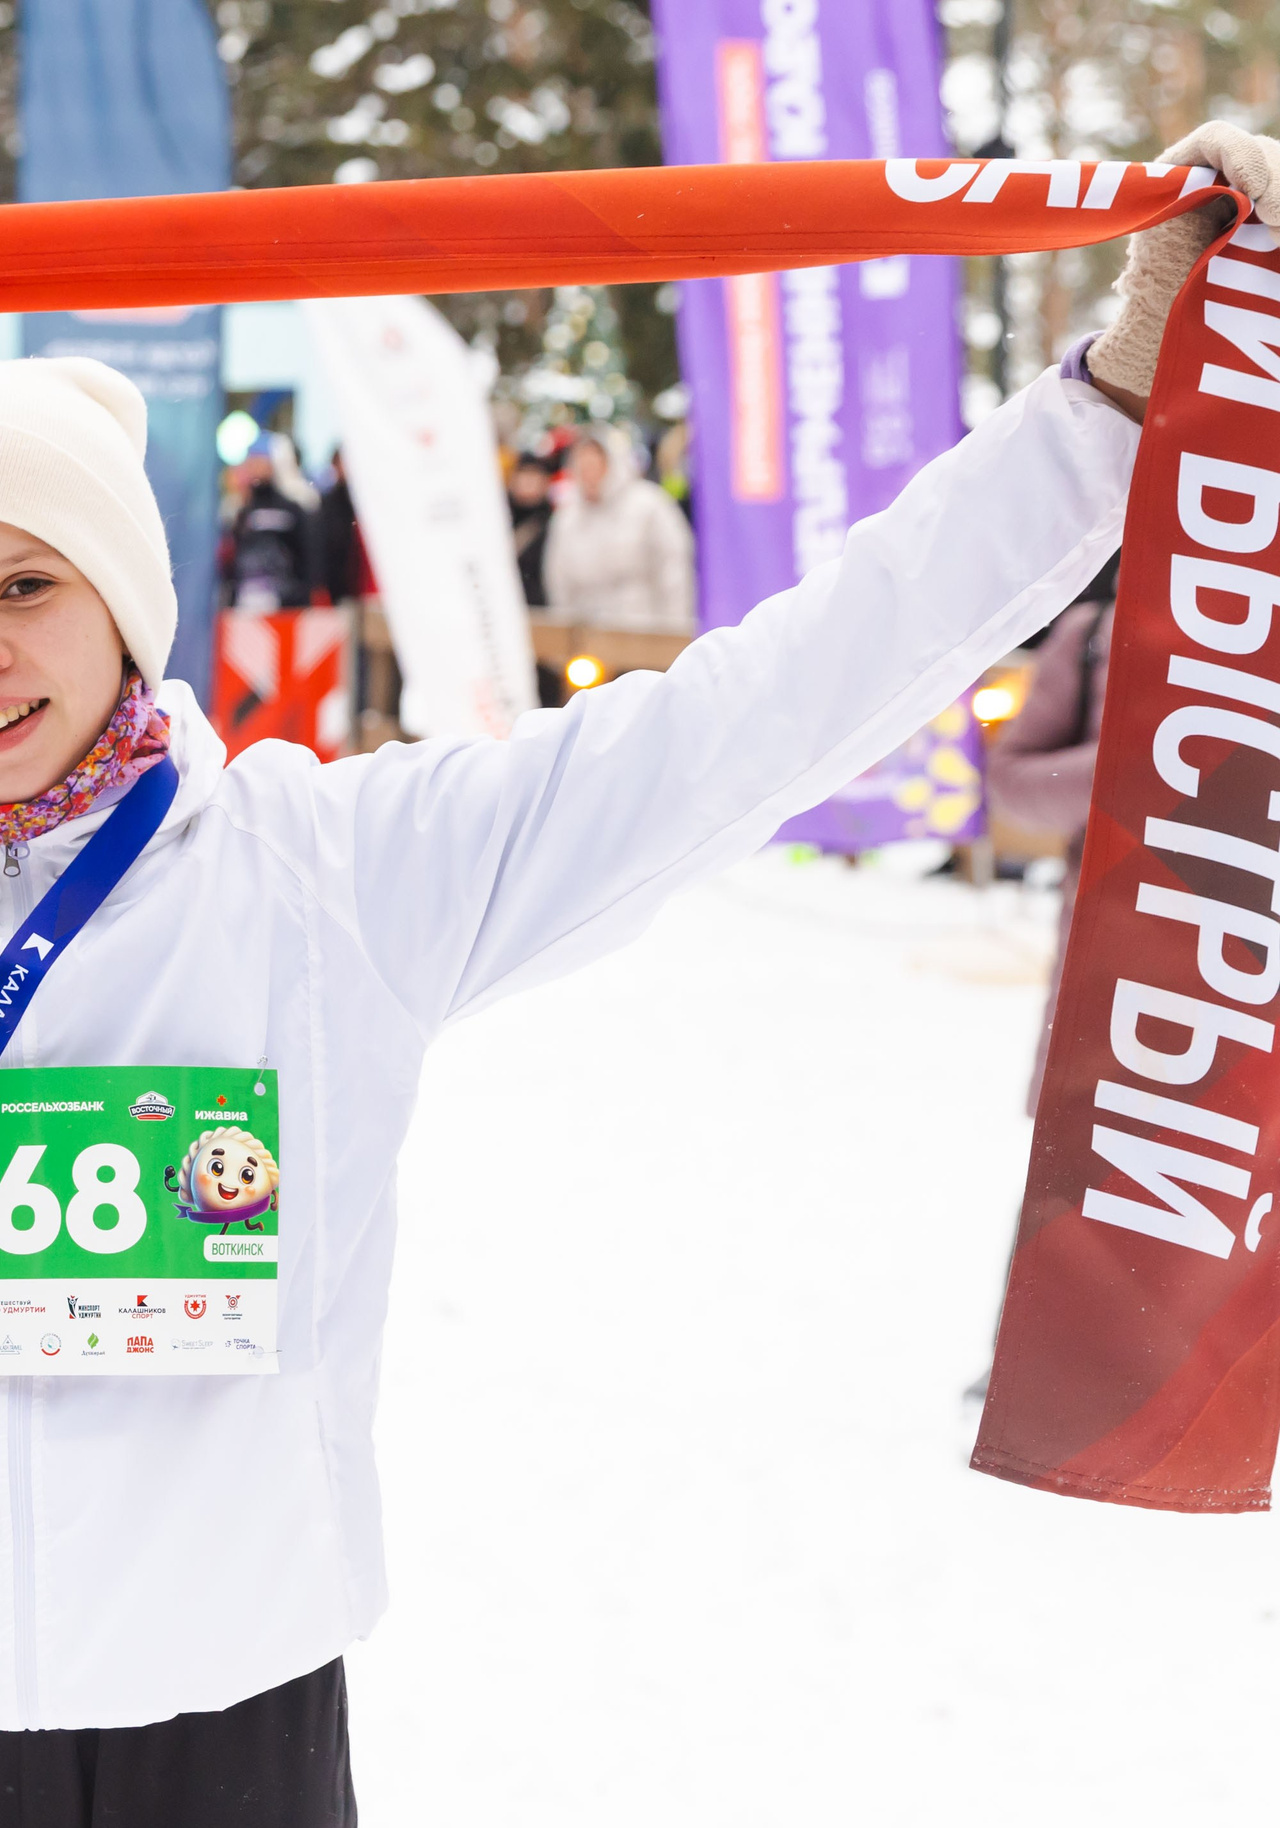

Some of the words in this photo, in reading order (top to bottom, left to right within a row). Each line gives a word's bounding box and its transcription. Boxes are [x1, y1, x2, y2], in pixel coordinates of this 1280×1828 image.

[1, 1101, 104, 1114] РОССЕЛЬХОЗБАНК
[131, 1105, 173, 1116] ВОСТОЧНЫЙ
[211, 1243, 264, 1256] ВОТКИНСК
[3, 1306, 46, 1314] УДМУРТИИ
[127, 1336, 154, 1346] ПАПА
